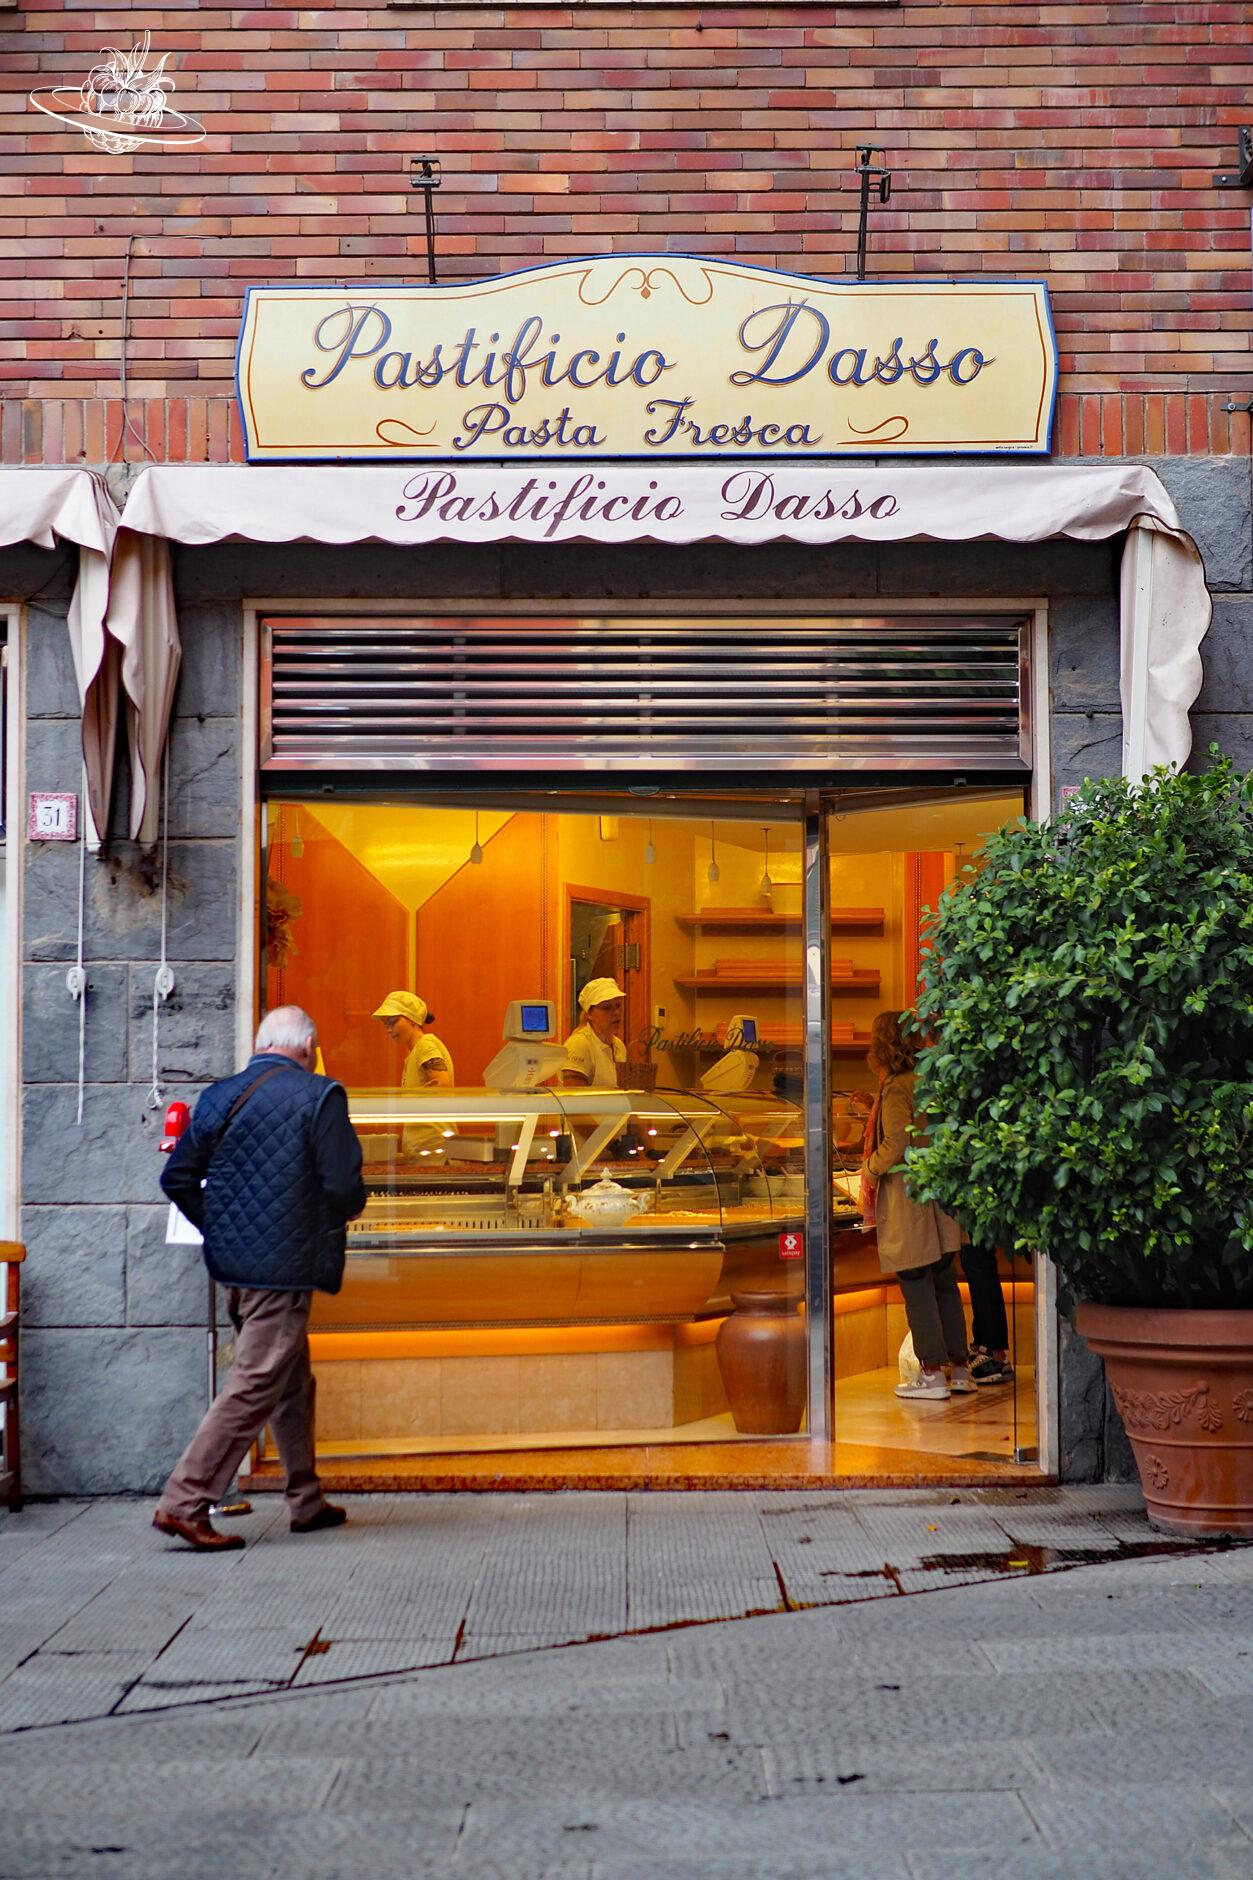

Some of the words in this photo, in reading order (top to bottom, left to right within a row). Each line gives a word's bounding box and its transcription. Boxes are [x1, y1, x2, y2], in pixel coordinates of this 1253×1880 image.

[301, 303, 677, 403] Pastificio
[730, 297, 997, 387] Dasso
[453, 403, 608, 449] Pasta
[644, 397, 823, 446] Fresca
[396, 470, 685, 537] Pastificio
[720, 470, 900, 521] Dasso
